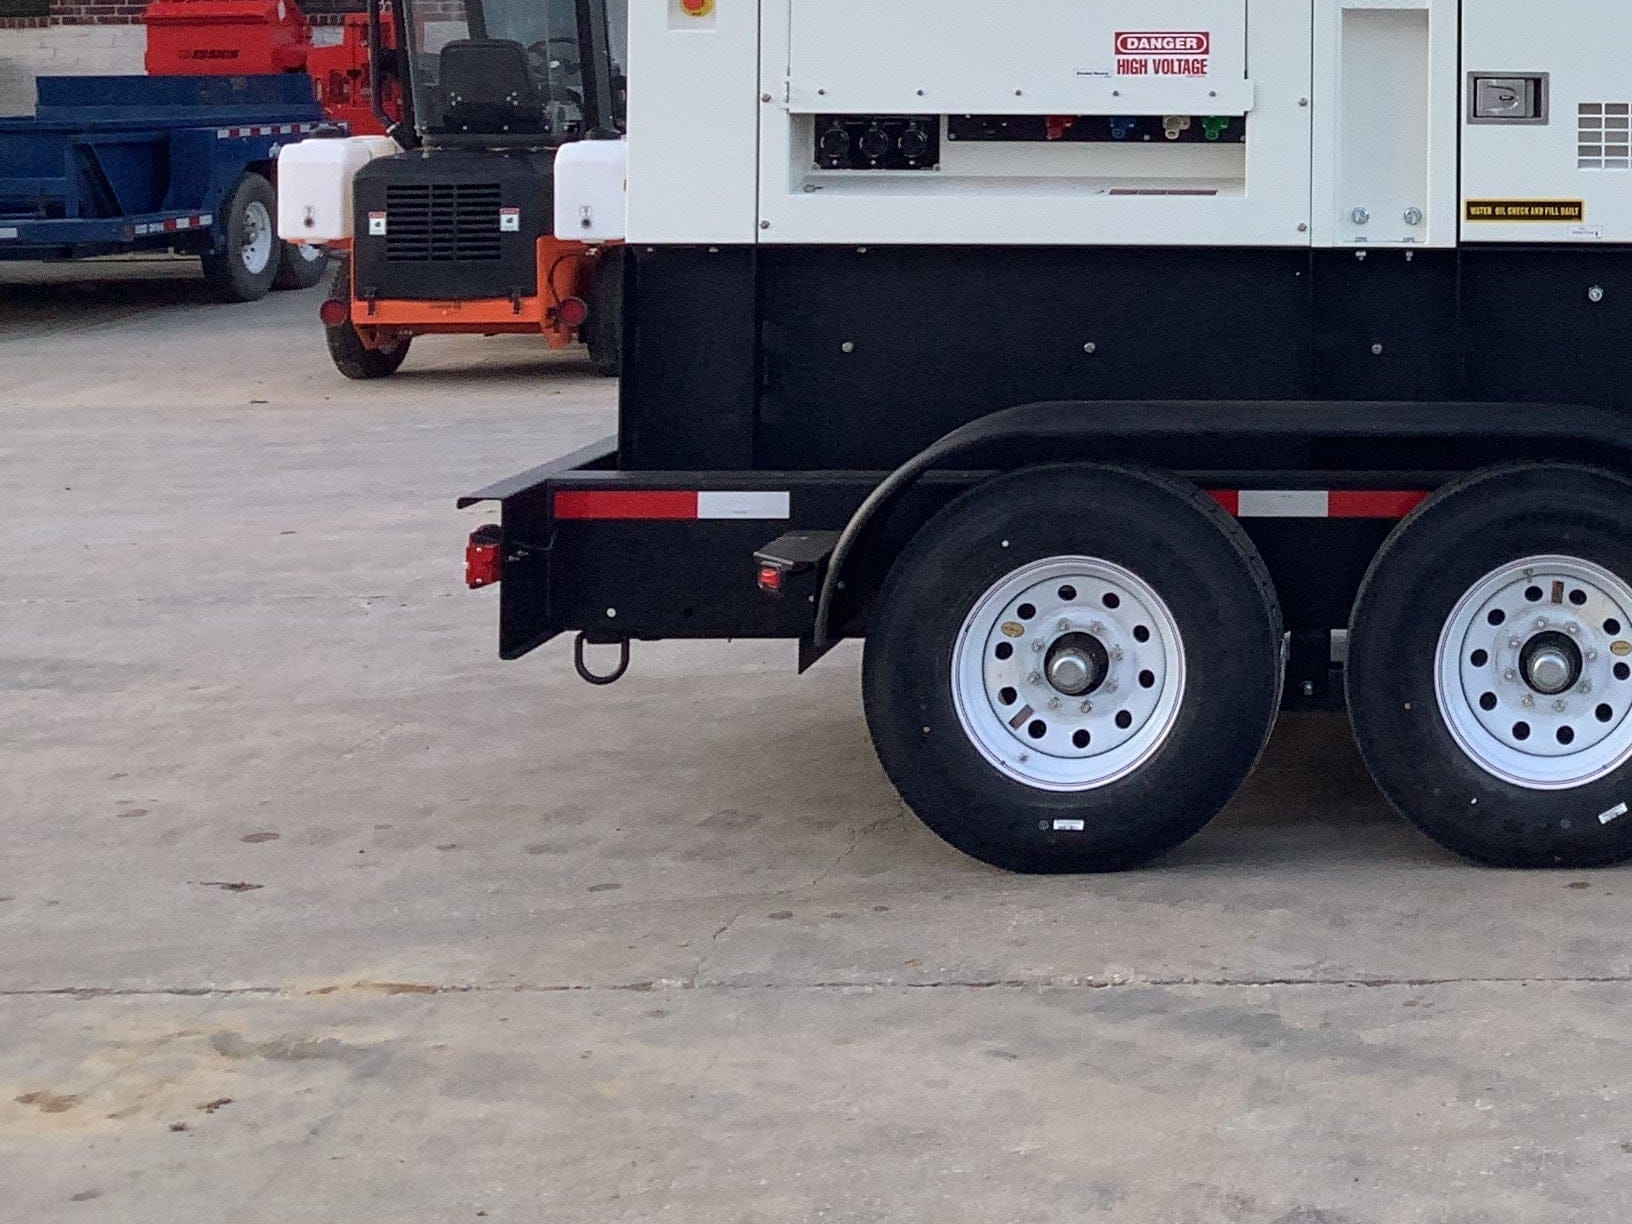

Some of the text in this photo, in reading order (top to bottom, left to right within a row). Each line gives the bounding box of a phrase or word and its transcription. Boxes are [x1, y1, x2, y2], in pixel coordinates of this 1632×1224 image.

[1126, 37, 1198, 49] DANGER
[1117, 58, 1208, 75] HIGH VOLTAGE
[1470, 206, 1492, 215] WATER
[1507, 206, 1530, 215] CHECK
[1530, 206, 1544, 215] AND
[1545, 206, 1559, 215] FILL
[1560, 206, 1579, 215] DAILY
